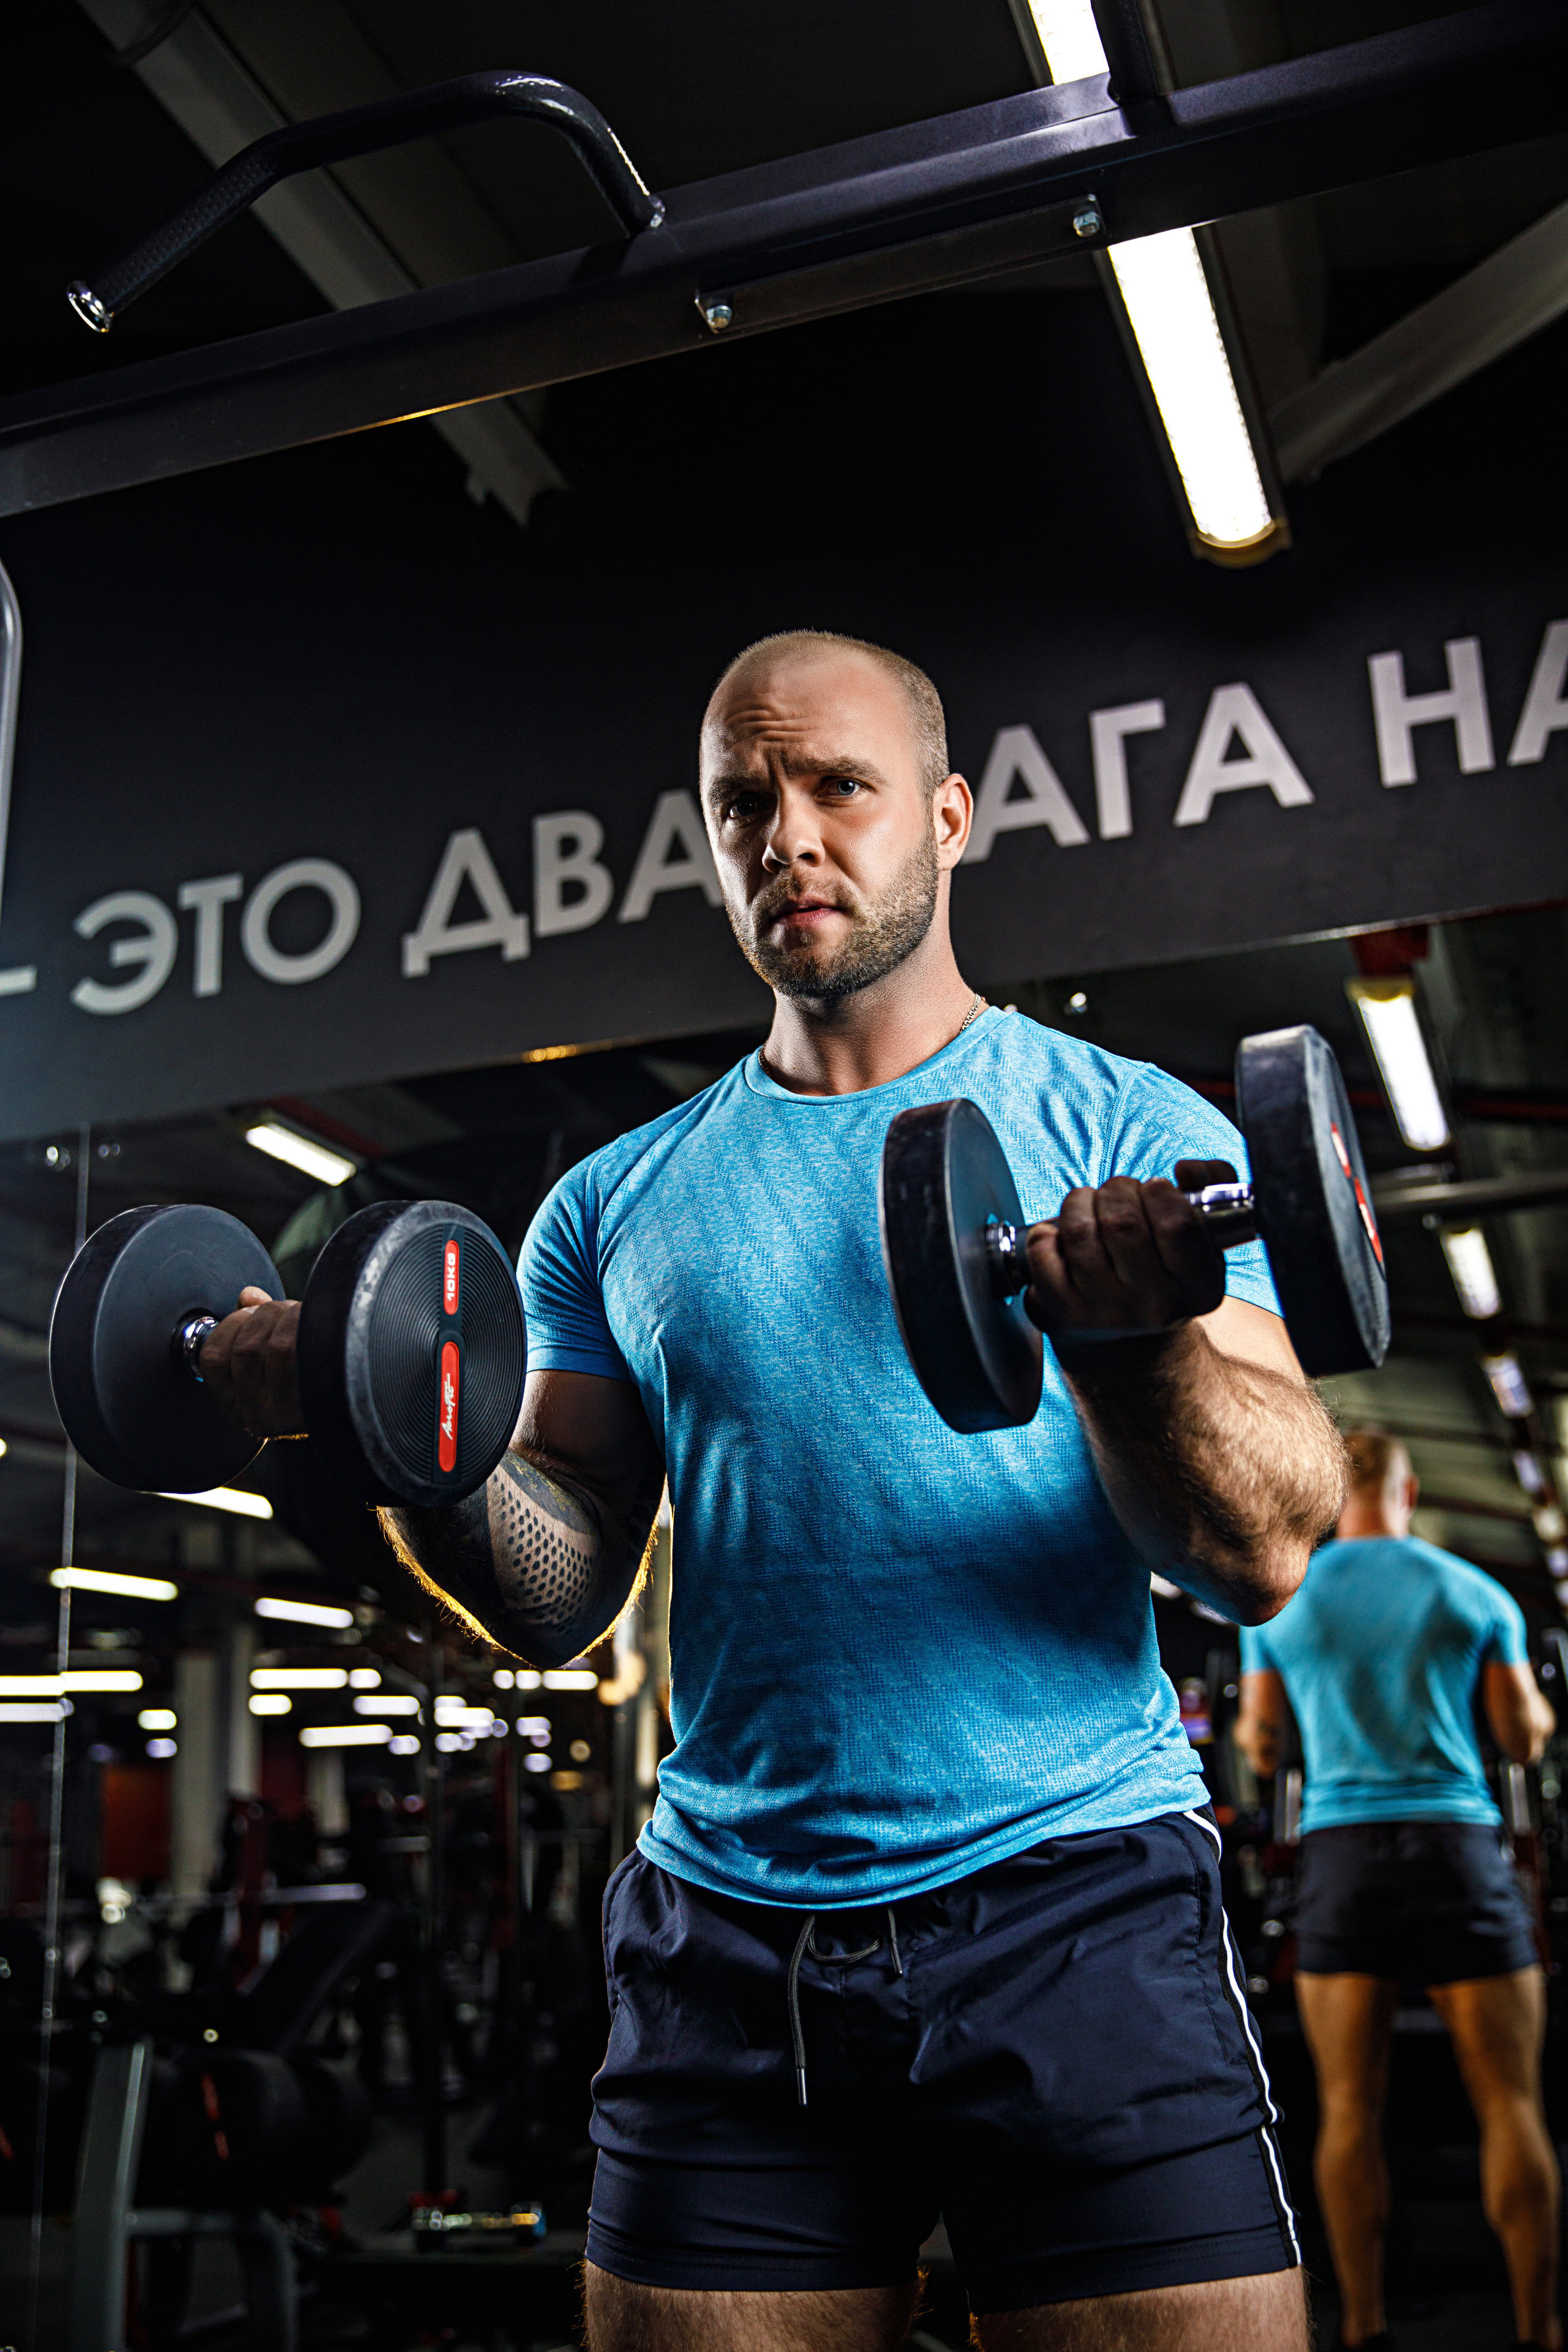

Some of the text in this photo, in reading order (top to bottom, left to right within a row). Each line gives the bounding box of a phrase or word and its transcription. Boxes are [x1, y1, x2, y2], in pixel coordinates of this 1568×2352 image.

[70, 858, 361, 1016] ЭТО
[402, 788, 725, 978] ДВА
[960, 681, 1315, 865] АГА
[447, 1252, 456, 1302] 10KG
